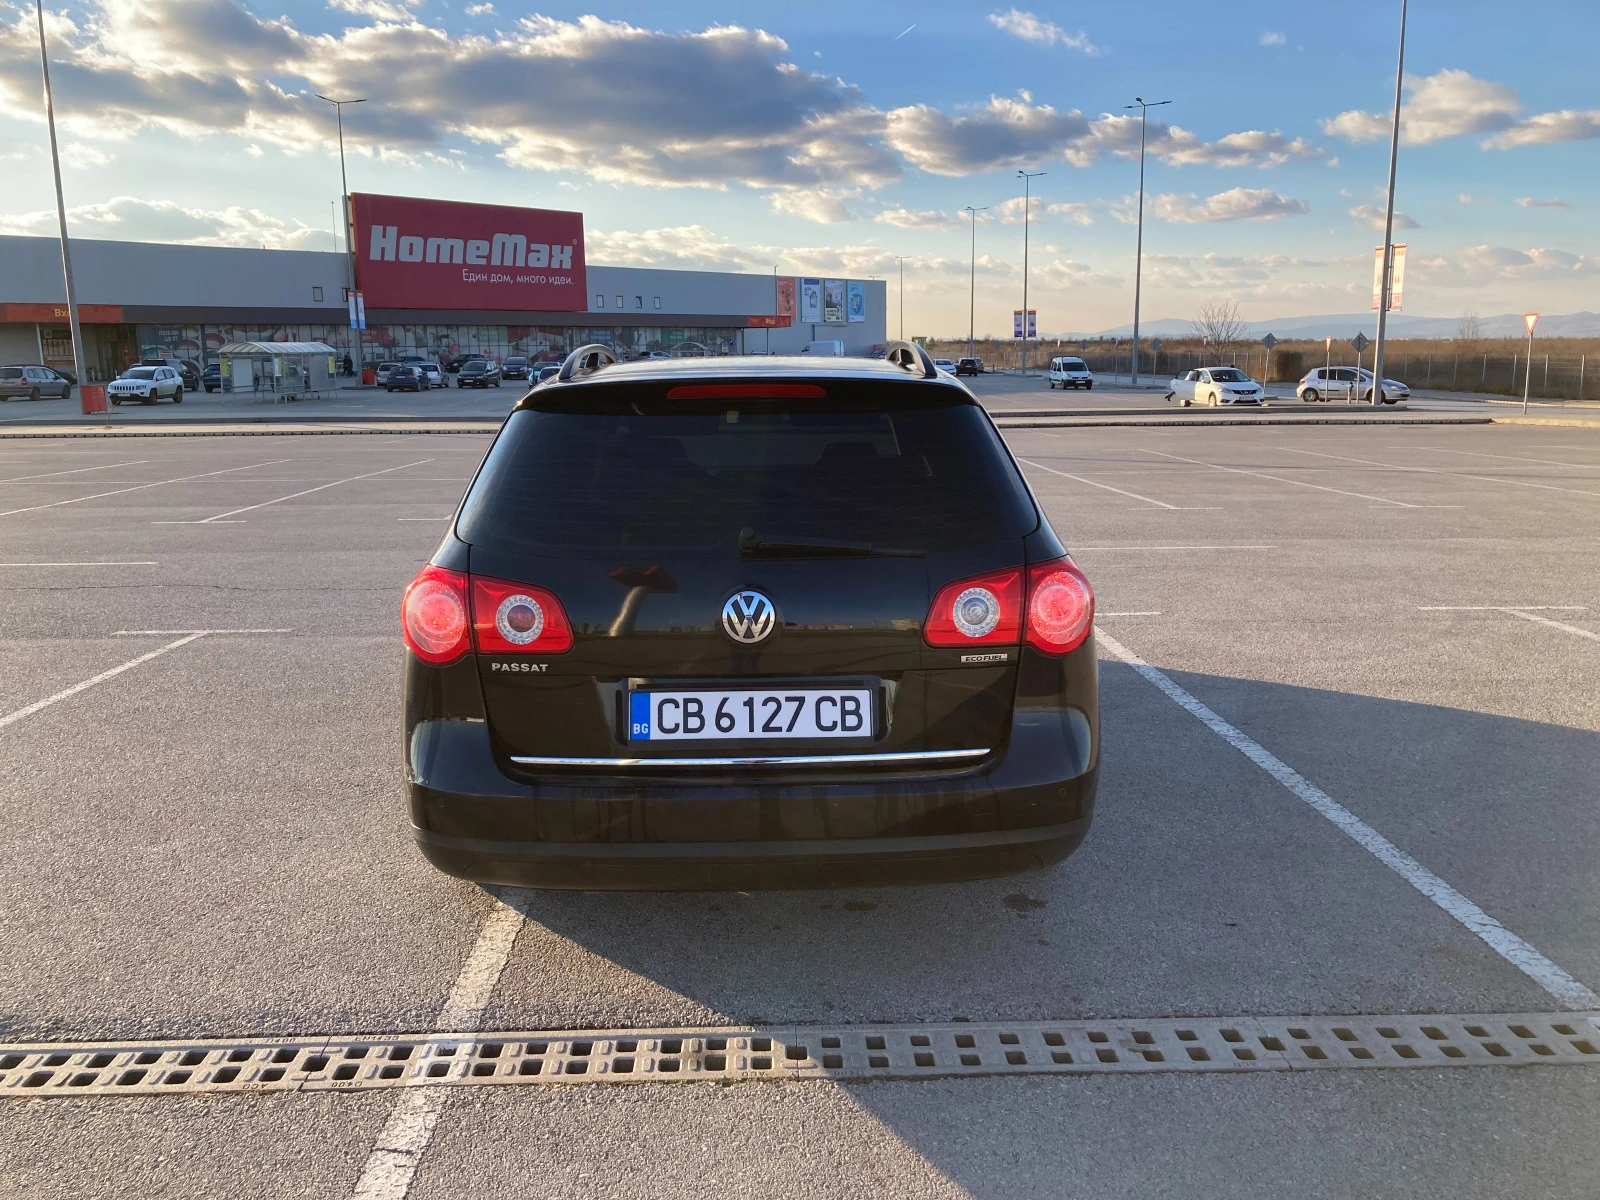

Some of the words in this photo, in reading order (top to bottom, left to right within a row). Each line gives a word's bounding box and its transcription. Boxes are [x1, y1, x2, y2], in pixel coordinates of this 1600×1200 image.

[369, 225, 573, 269] HomeMax
[462, 269, 488, 282] Един
[490, 273, 514, 285] дом,
[516, 275, 546, 284] много
[549, 276, 574, 286] идеи.
[491, 662, 549, 672] PASSAT
[657, 698, 706, 734] CB
[714, 696, 806, 733] 6127
[815, 695, 863, 732] CB
[633, 723, 649, 734] BG
